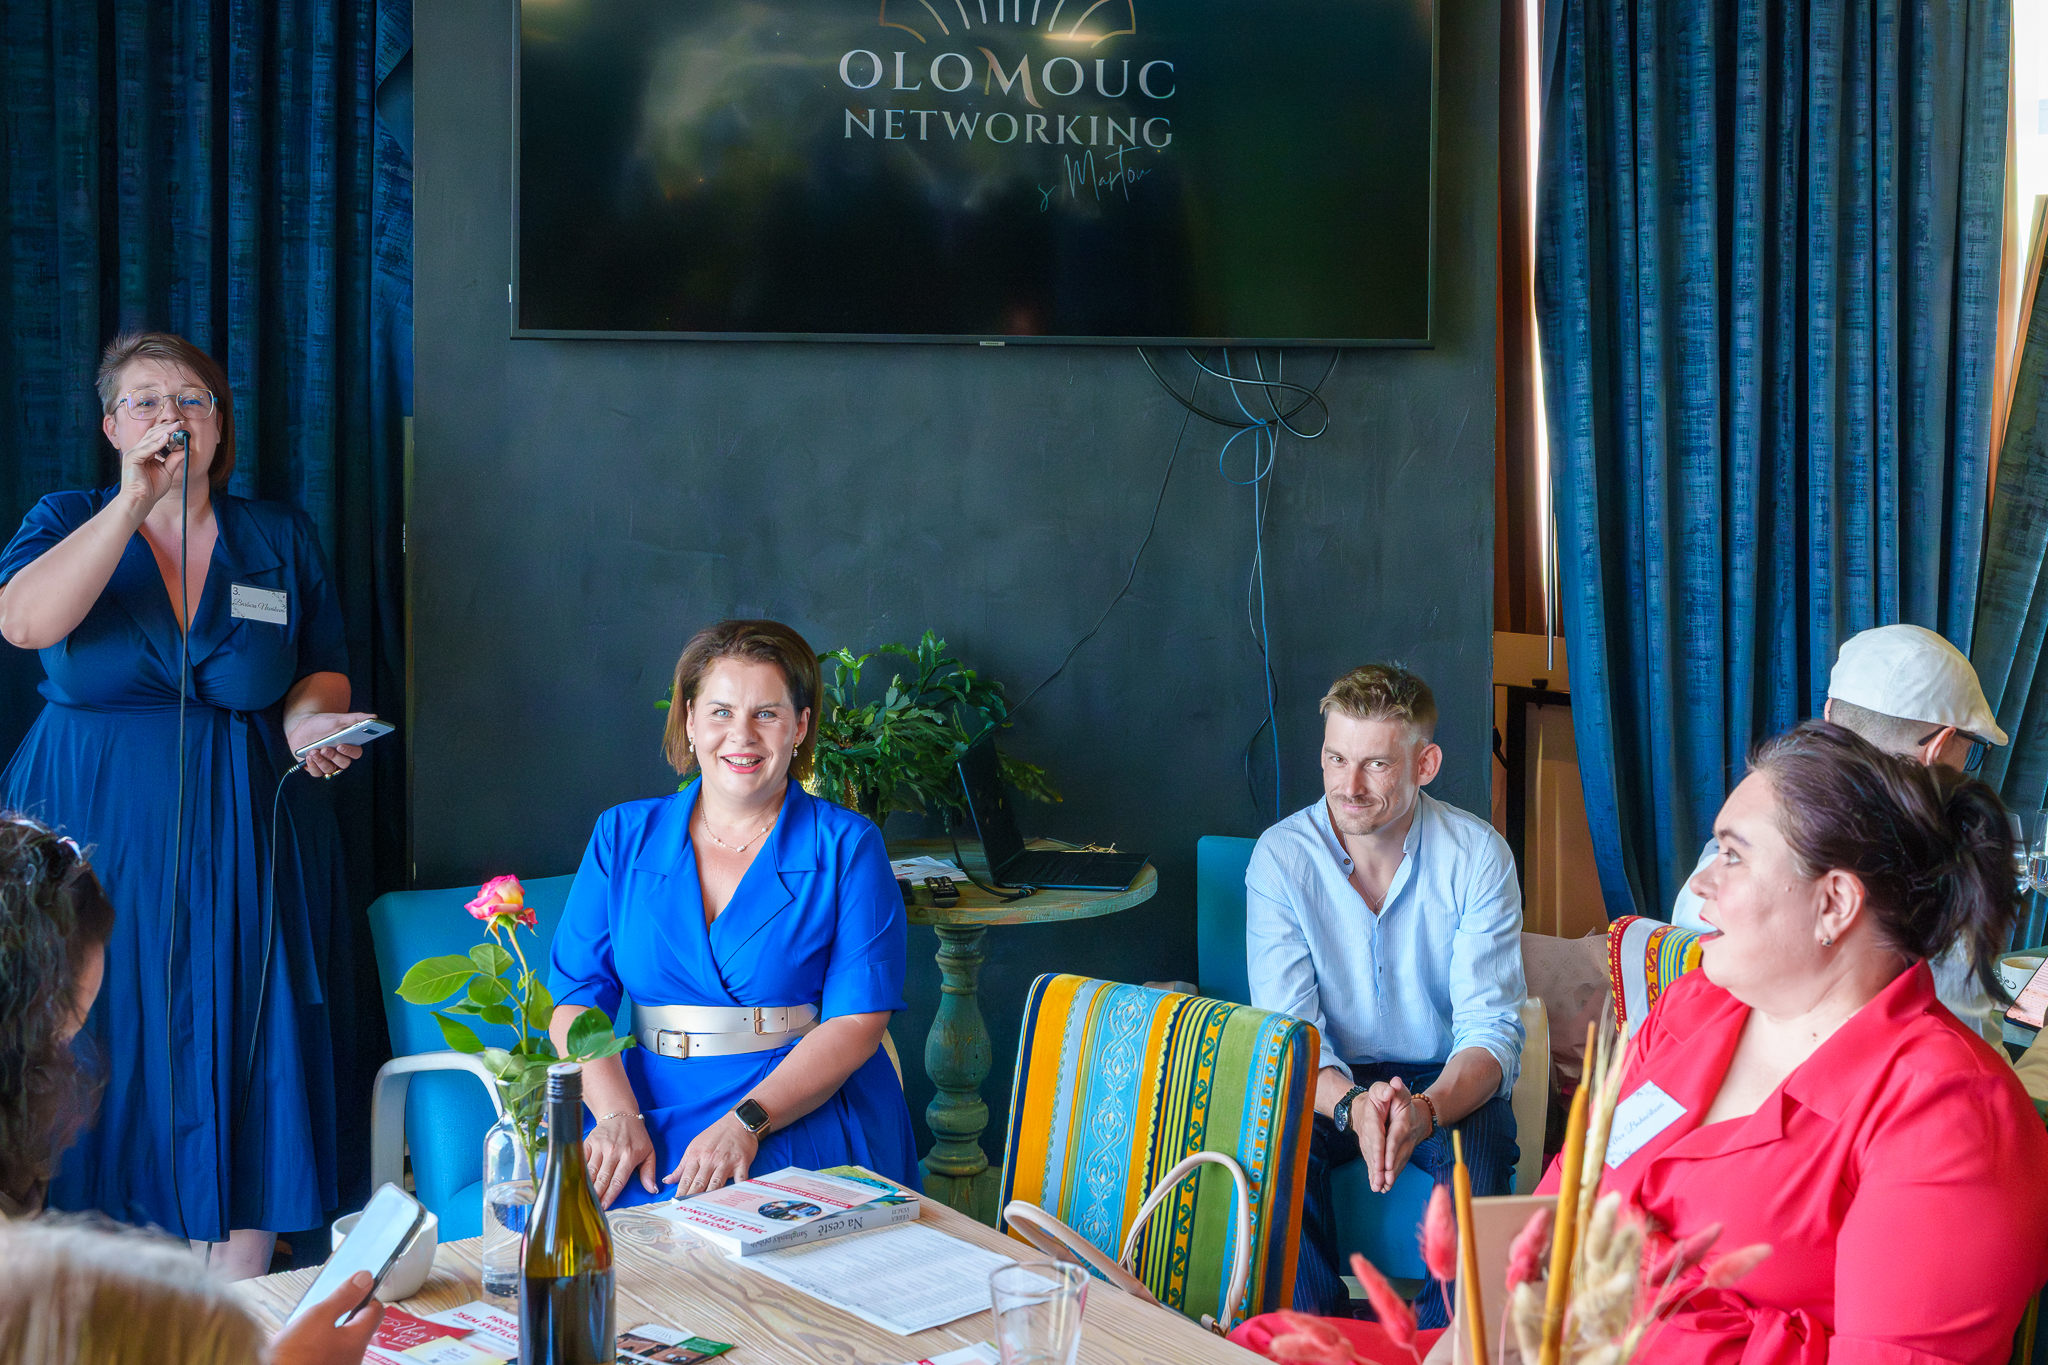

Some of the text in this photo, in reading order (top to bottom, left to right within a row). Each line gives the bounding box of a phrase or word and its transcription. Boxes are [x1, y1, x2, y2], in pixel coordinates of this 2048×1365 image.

[838, 46, 1176, 108] OLOMOUC
[844, 108, 1174, 148] NETWORKING
[232, 587, 240, 596] 3.
[686, 1216, 735, 1231] PROJEKT
[737, 1223, 767, 1234] JSEM
[817, 1217, 864, 1236] Na cestě
